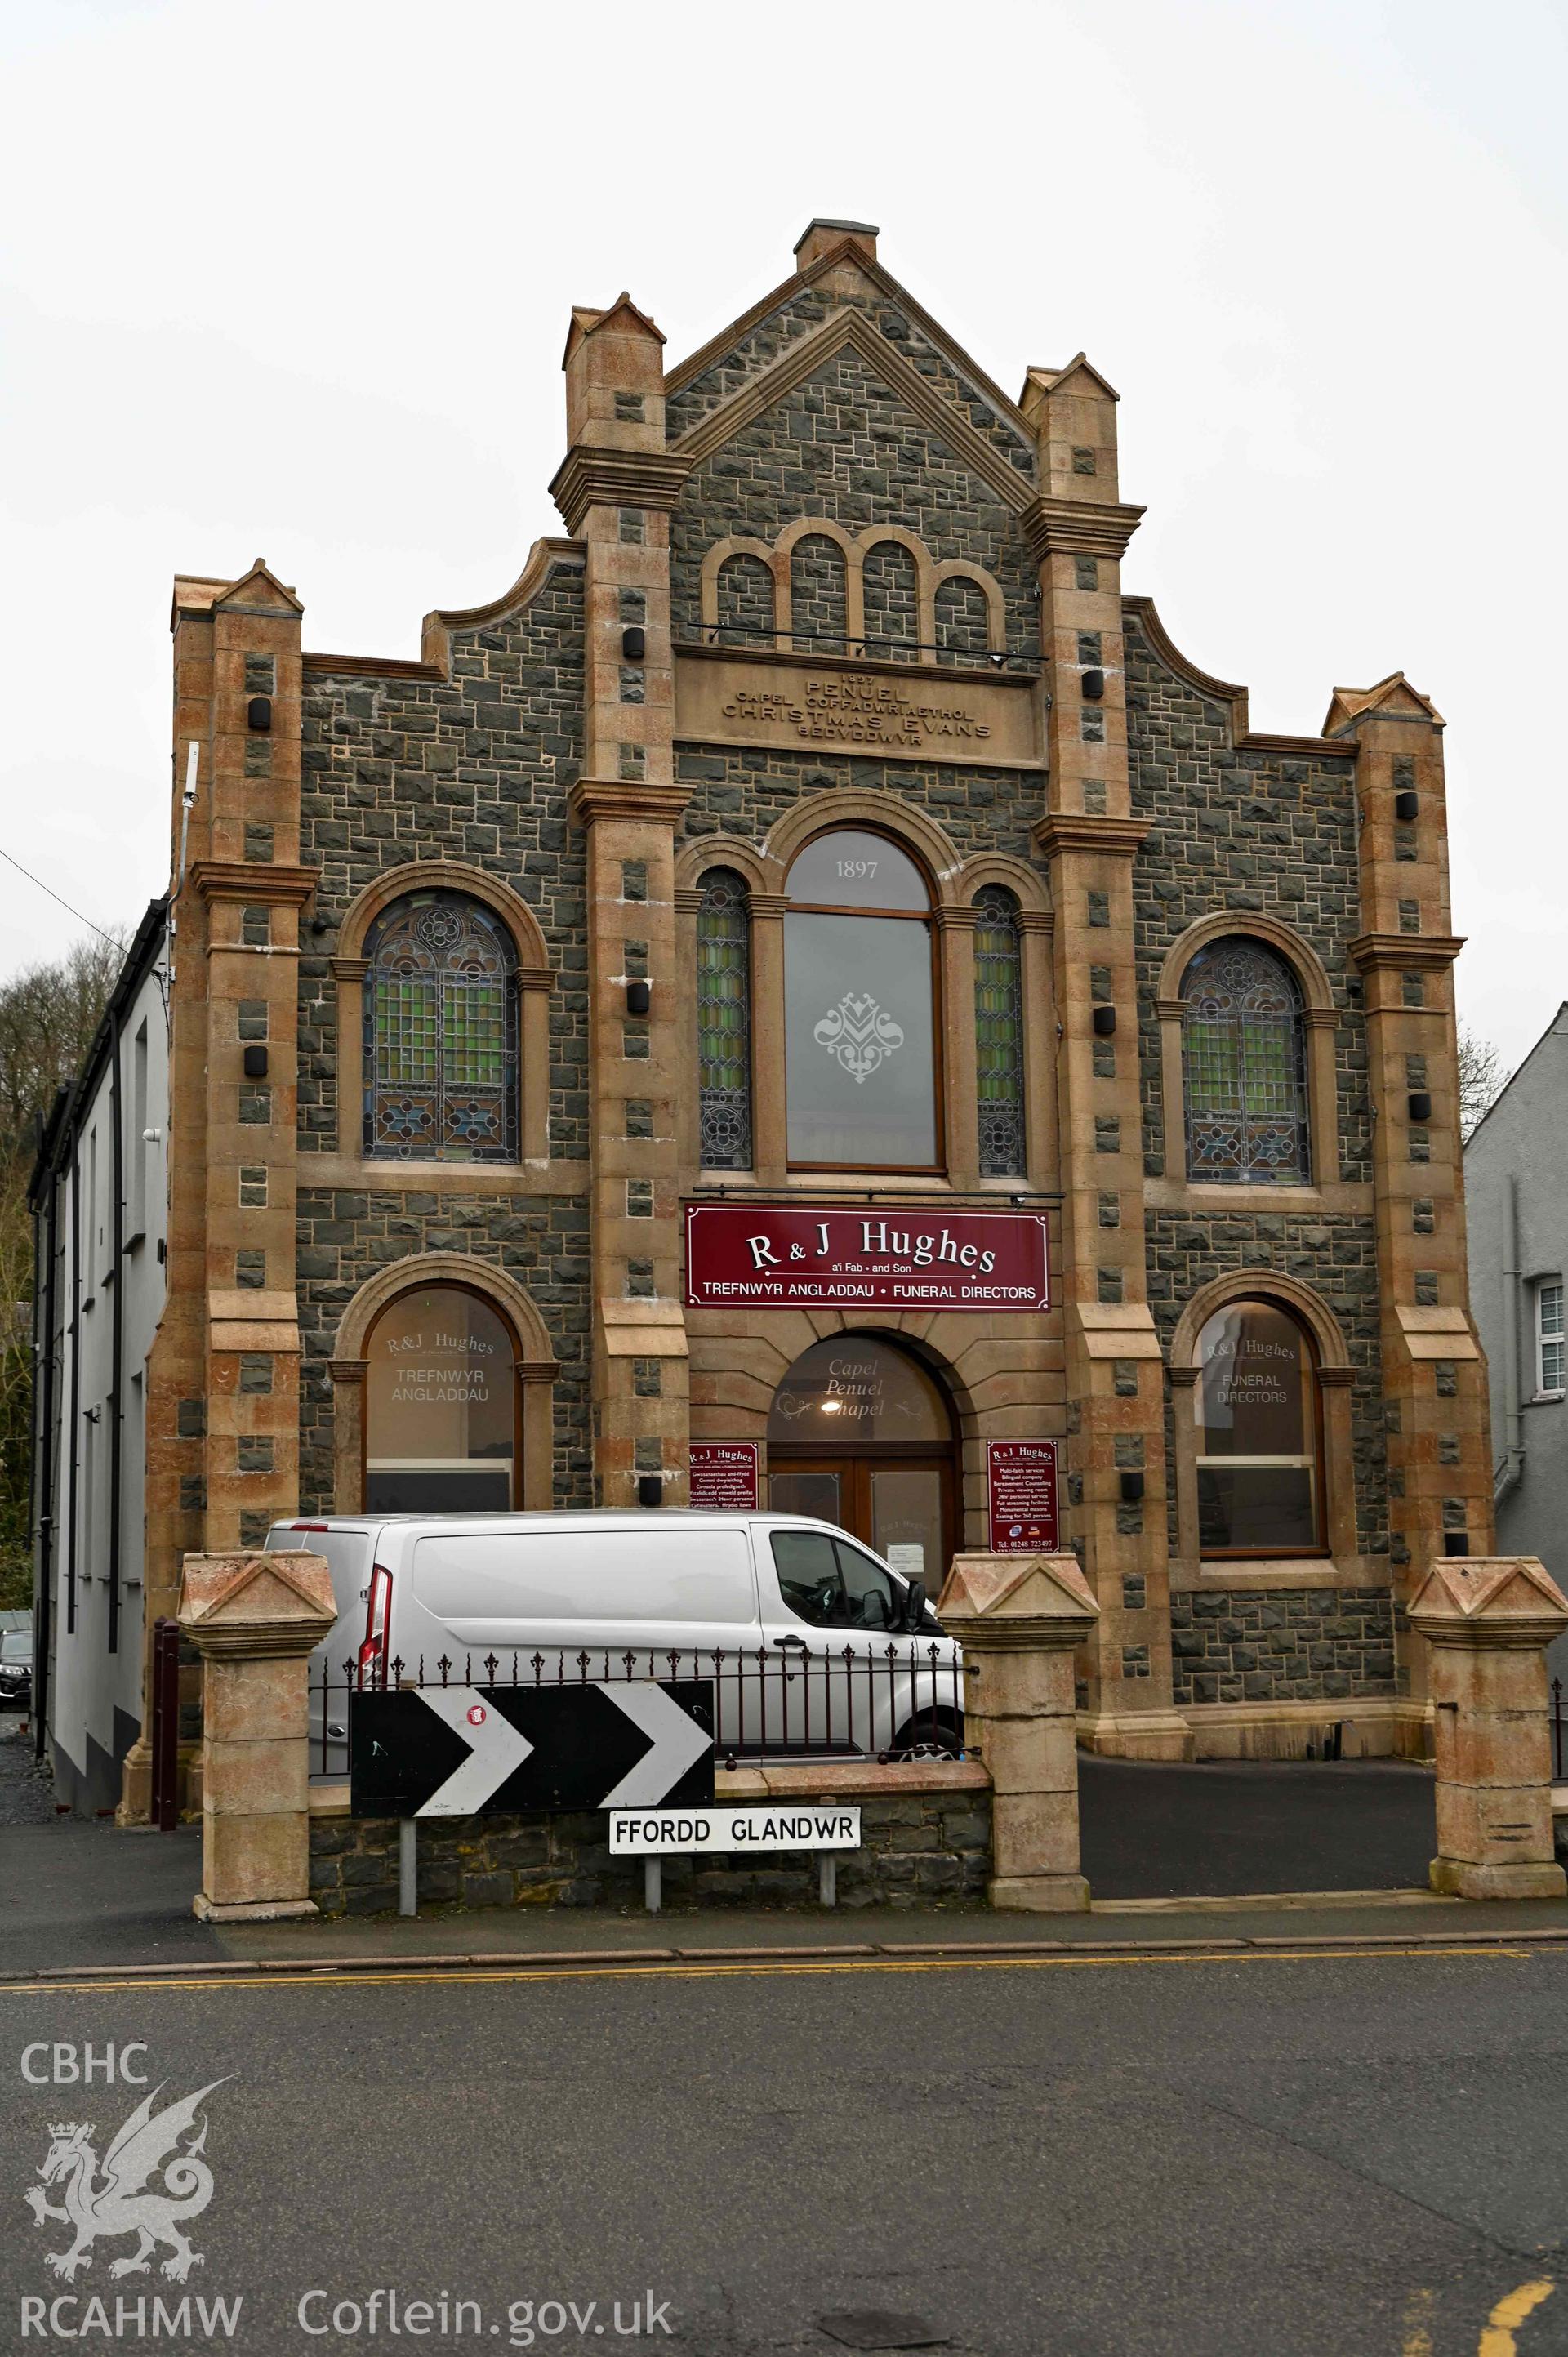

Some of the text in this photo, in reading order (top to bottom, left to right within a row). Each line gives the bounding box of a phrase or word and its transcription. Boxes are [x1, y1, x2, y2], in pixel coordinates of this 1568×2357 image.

[841, 674, 874, 684] 1897
[806, 681, 910, 703] PENUEL
[736, 692, 974, 721] CAPEL COFFADWRIAETHOL
[723, 705, 991, 738] CHRISTMAS EVANS
[798, 724, 922, 746] BEDYDDWYR
[835, 860, 879, 879] 1897
[746, 1221, 996, 1272] R & J Hughes
[845, 1263, 863, 1272] Fab
[872, 1264, 890, 1273] and
[893, 1264, 911, 1273] Son
[702, 1282, 1036, 1299] TREFNWYR ANGLADDAU FUNERAL DIRECTORS
[435, 1333, 494, 1355] Hughes
[1246, 1339, 1295, 1360] Hughes
[395, 1370, 484, 1383] TREFNWYR
[829, 1359, 879, 1379] Capel
[825, 1379, 884, 1396] Penuel
[1223, 1375, 1281, 1386] FUNERAL
[392, 1388, 489, 1401] ANGLADDAU
[1217, 1391, 1287, 1403] DIRECTORS
[717, 1449, 753, 1463] Hughes
[1019, 1446, 1053, 1460] Hughes
[1031, 1539, 1053, 1548] 723497
[616, 1816, 854, 1843] FFORDD GLANDWR
